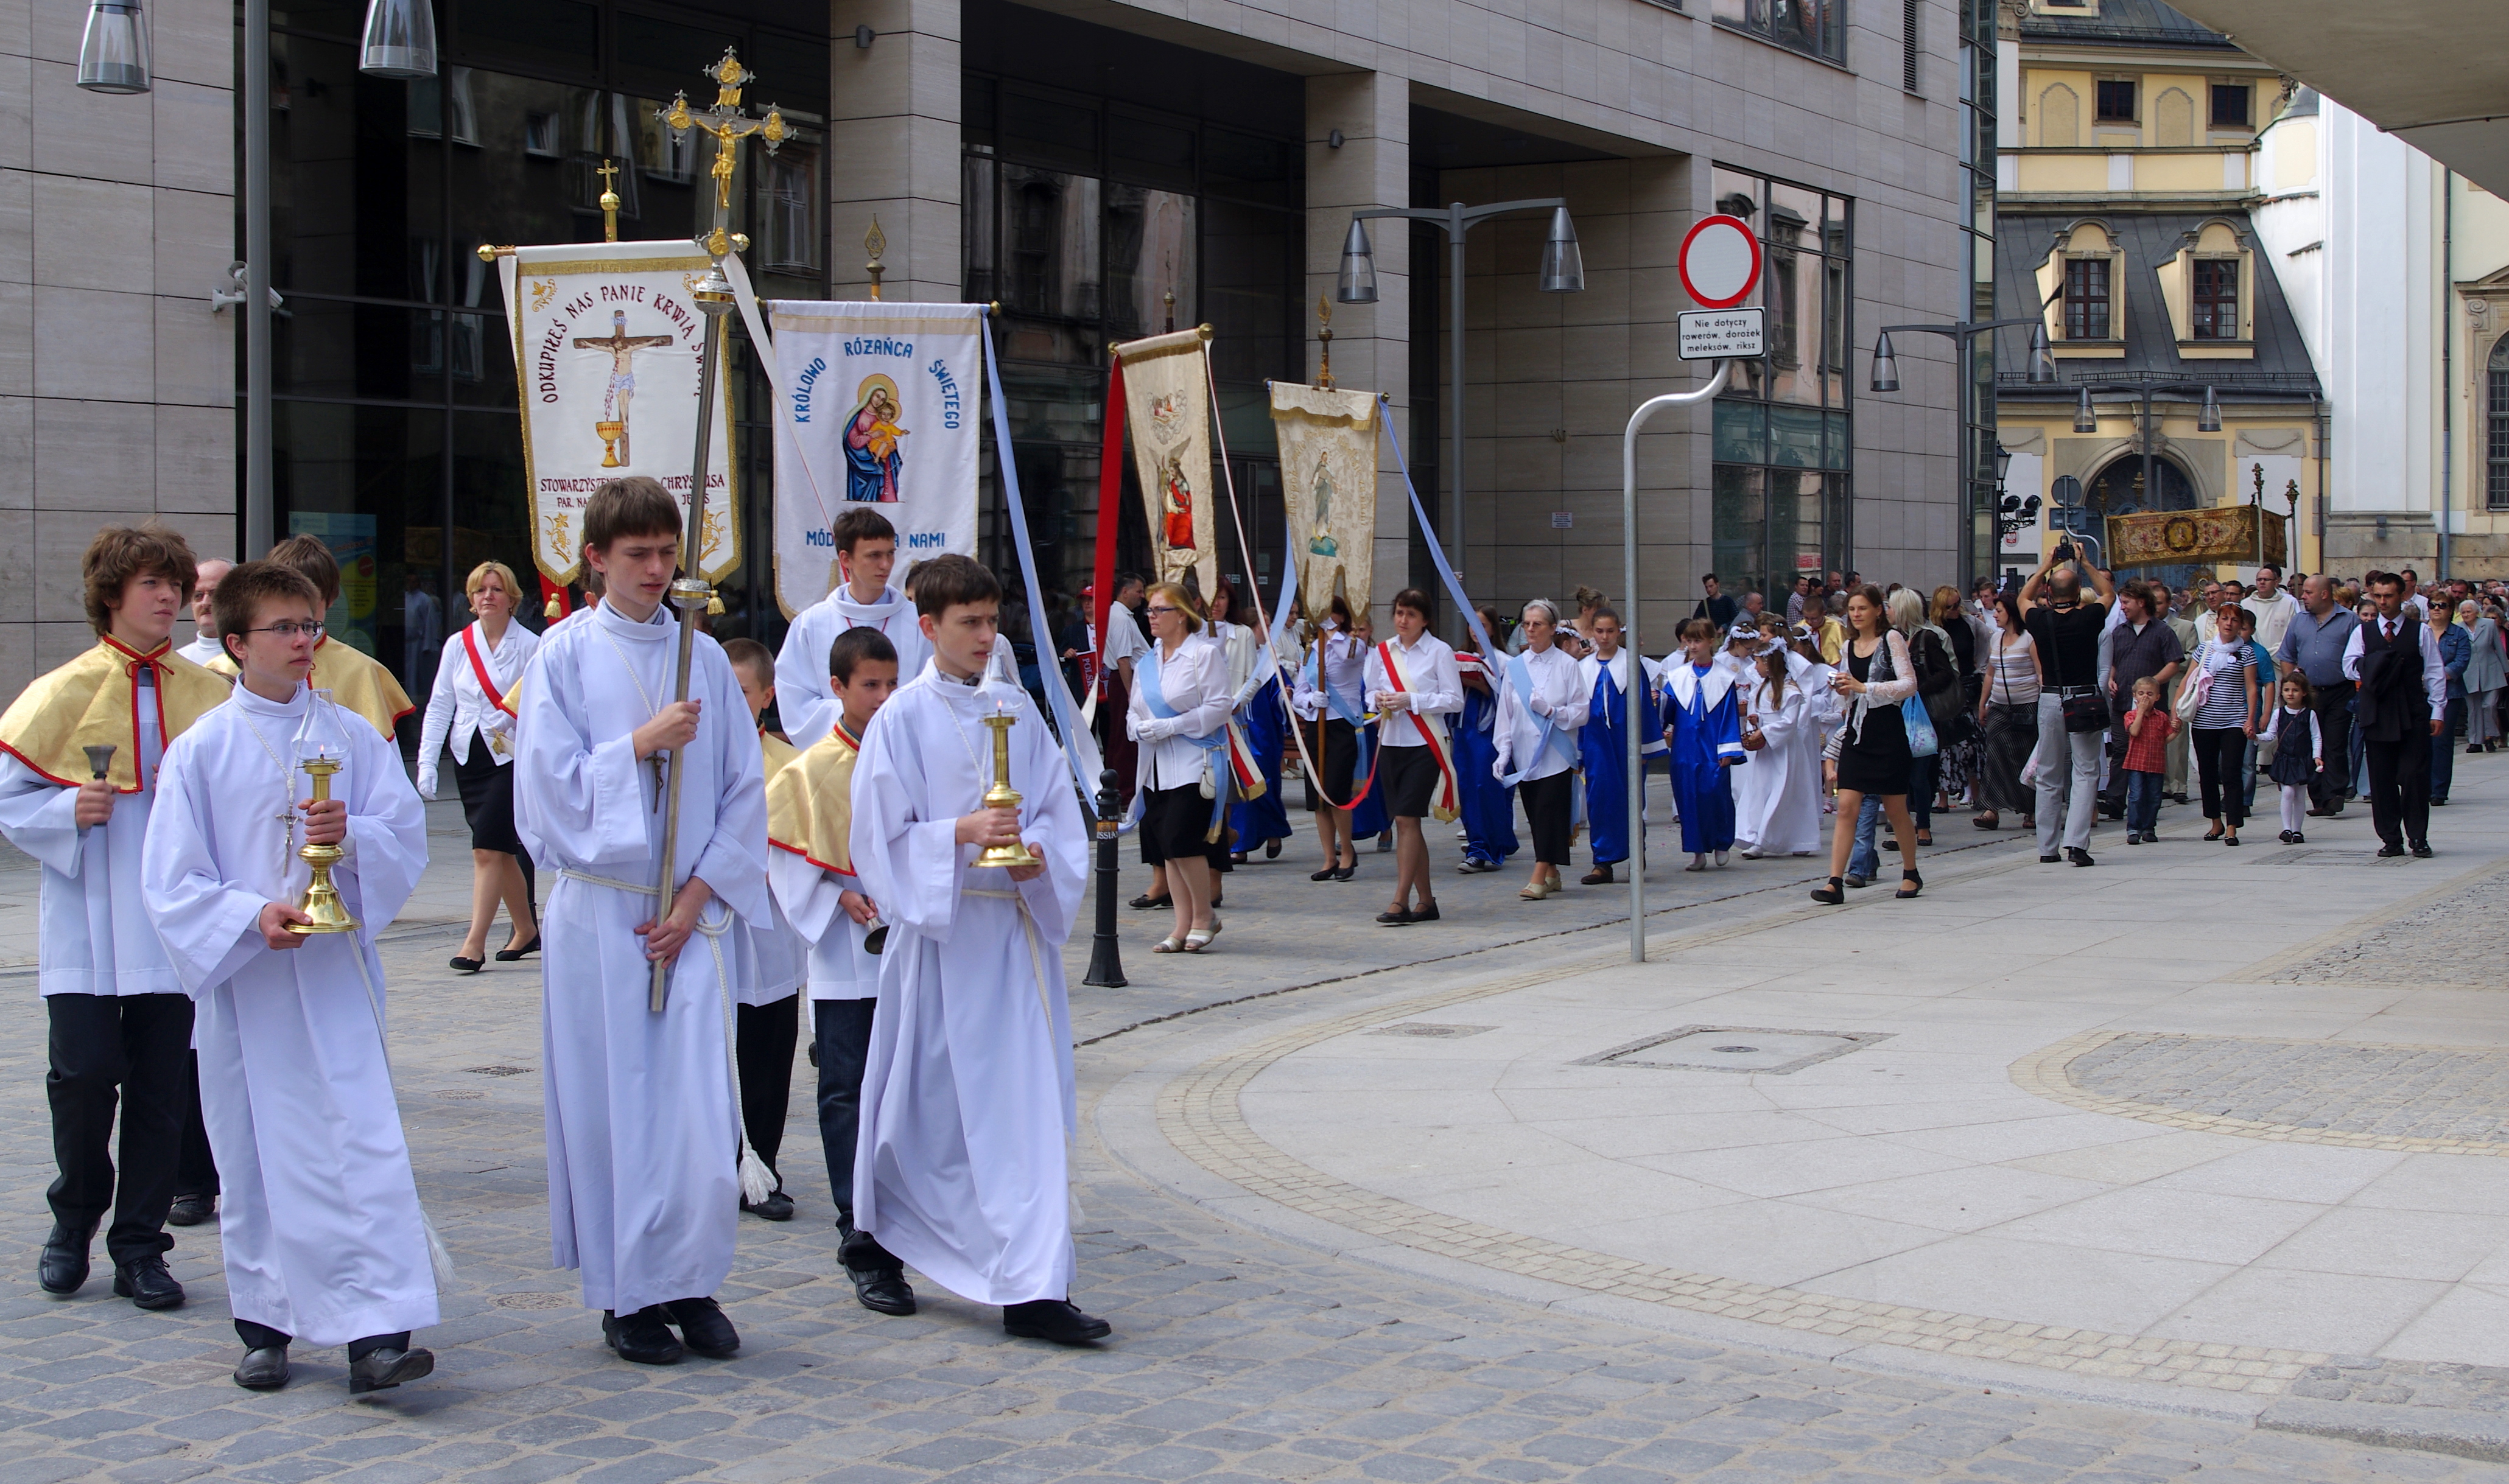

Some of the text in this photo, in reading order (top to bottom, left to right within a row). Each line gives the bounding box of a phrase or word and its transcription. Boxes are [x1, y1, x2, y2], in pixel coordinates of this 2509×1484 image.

[1714, 319, 1747, 328] dotyczy
[1725, 329, 1761, 338] dorożek
[538, 317, 567, 404] ODKUPIŁEŚ
[565, 292, 594, 319] NAS
[600, 285, 646, 303] PANIE
[791, 357, 827, 423] KRÓLOWO
[928, 359, 960, 429] ŚWIĘTEGO
[556, 497, 575, 508] PAR.
[682, 493, 710, 505] JES
[807, 528, 835, 547] MÓD
[910, 532, 945, 548] NAMI
